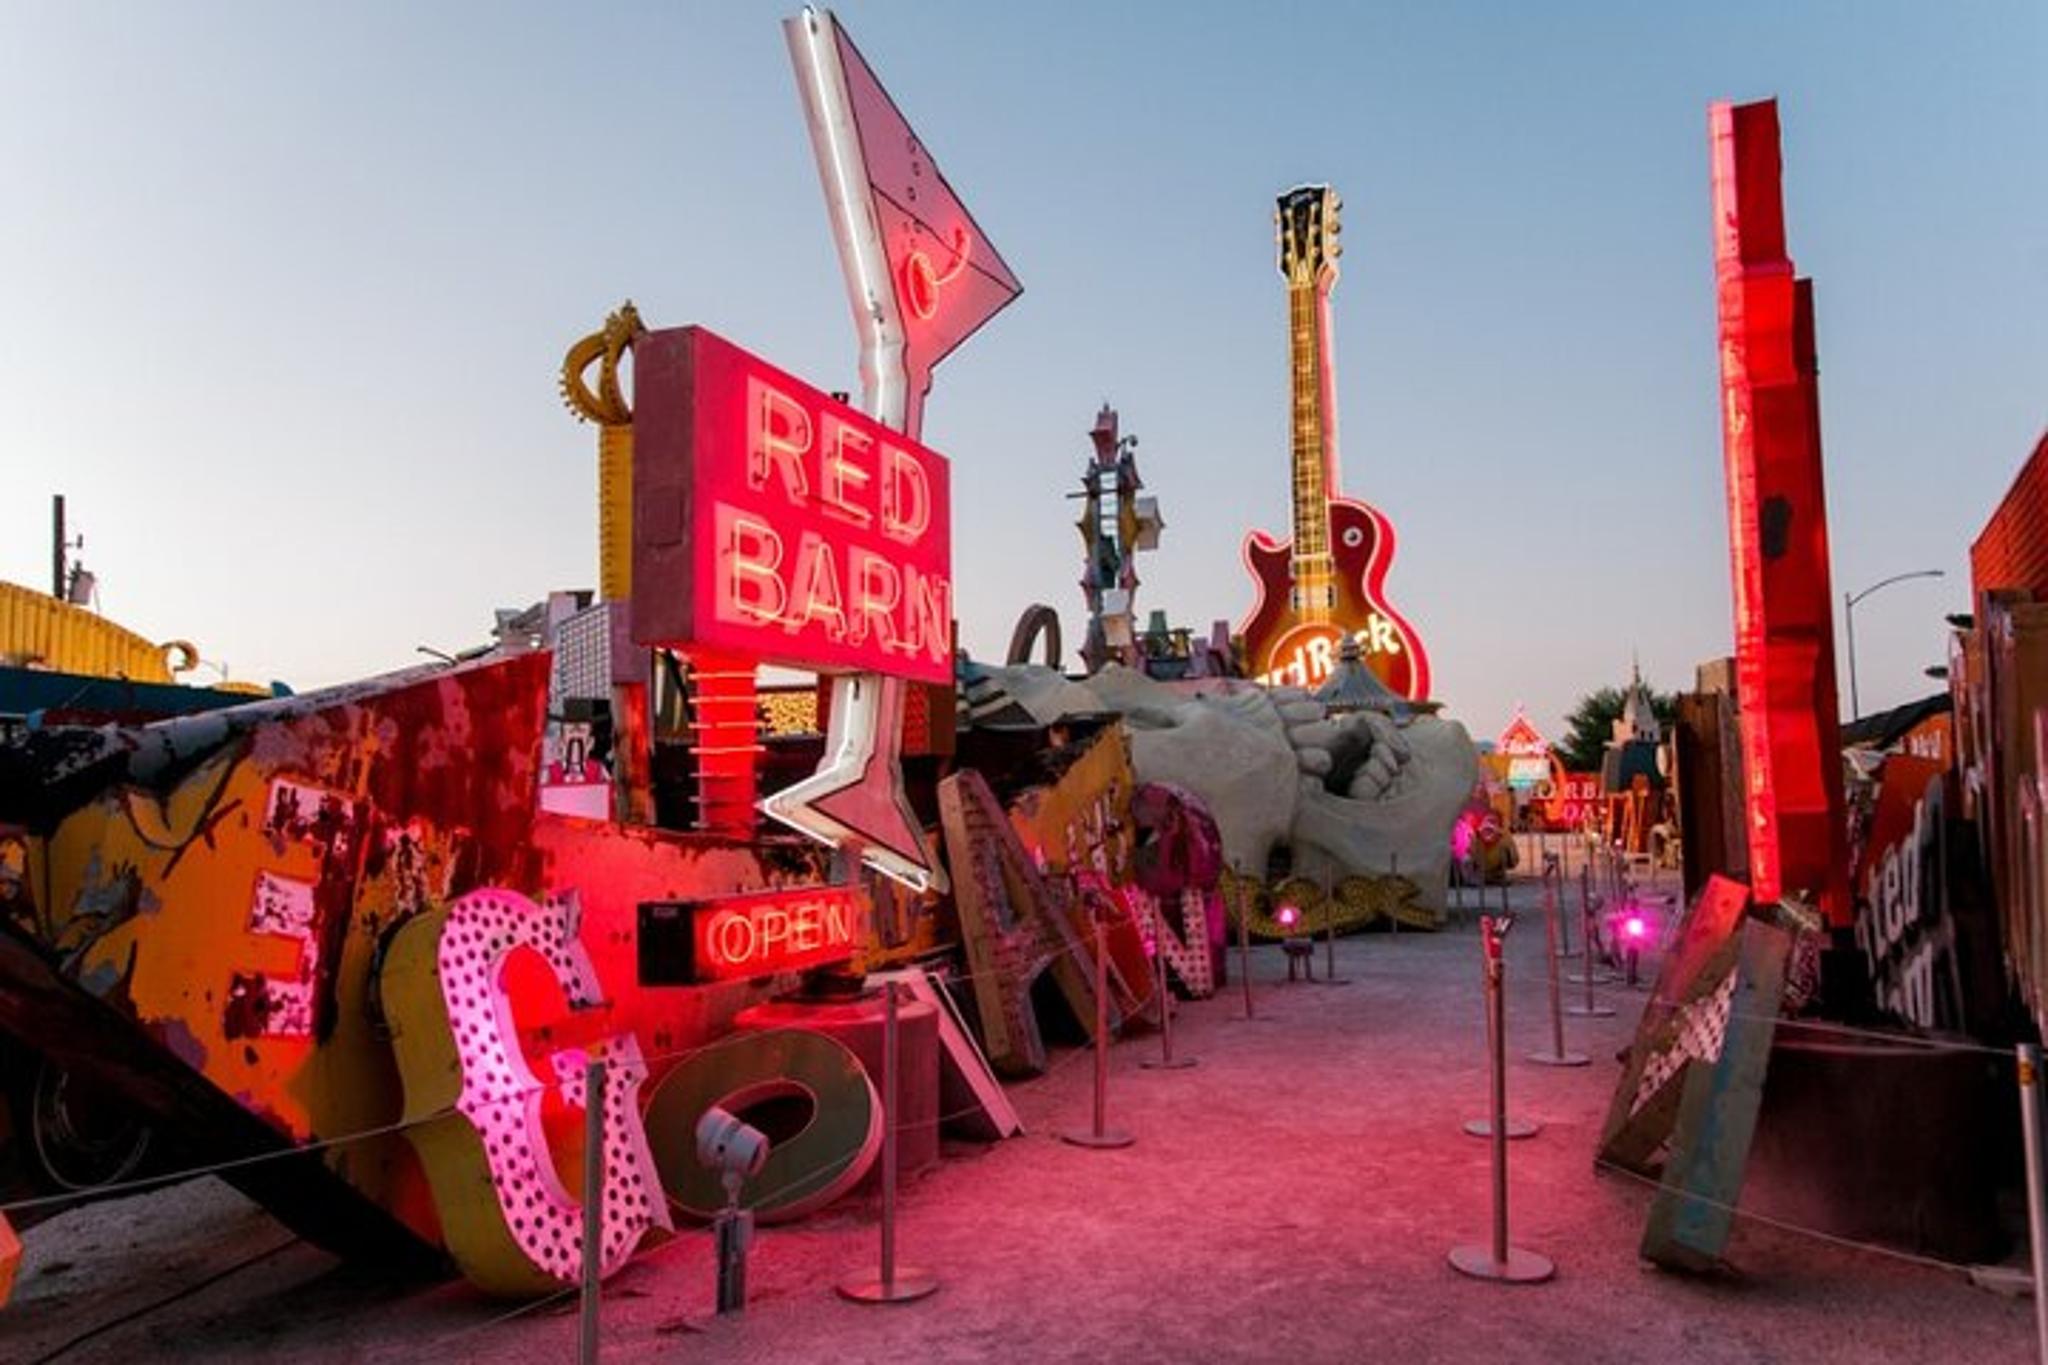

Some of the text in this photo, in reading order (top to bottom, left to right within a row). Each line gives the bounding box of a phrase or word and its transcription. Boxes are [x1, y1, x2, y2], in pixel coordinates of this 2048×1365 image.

[746, 374, 931, 546] RED
[713, 500, 950, 665] BARN
[1305, 612, 1400, 680] Rck
[707, 899, 854, 964] OPEN
